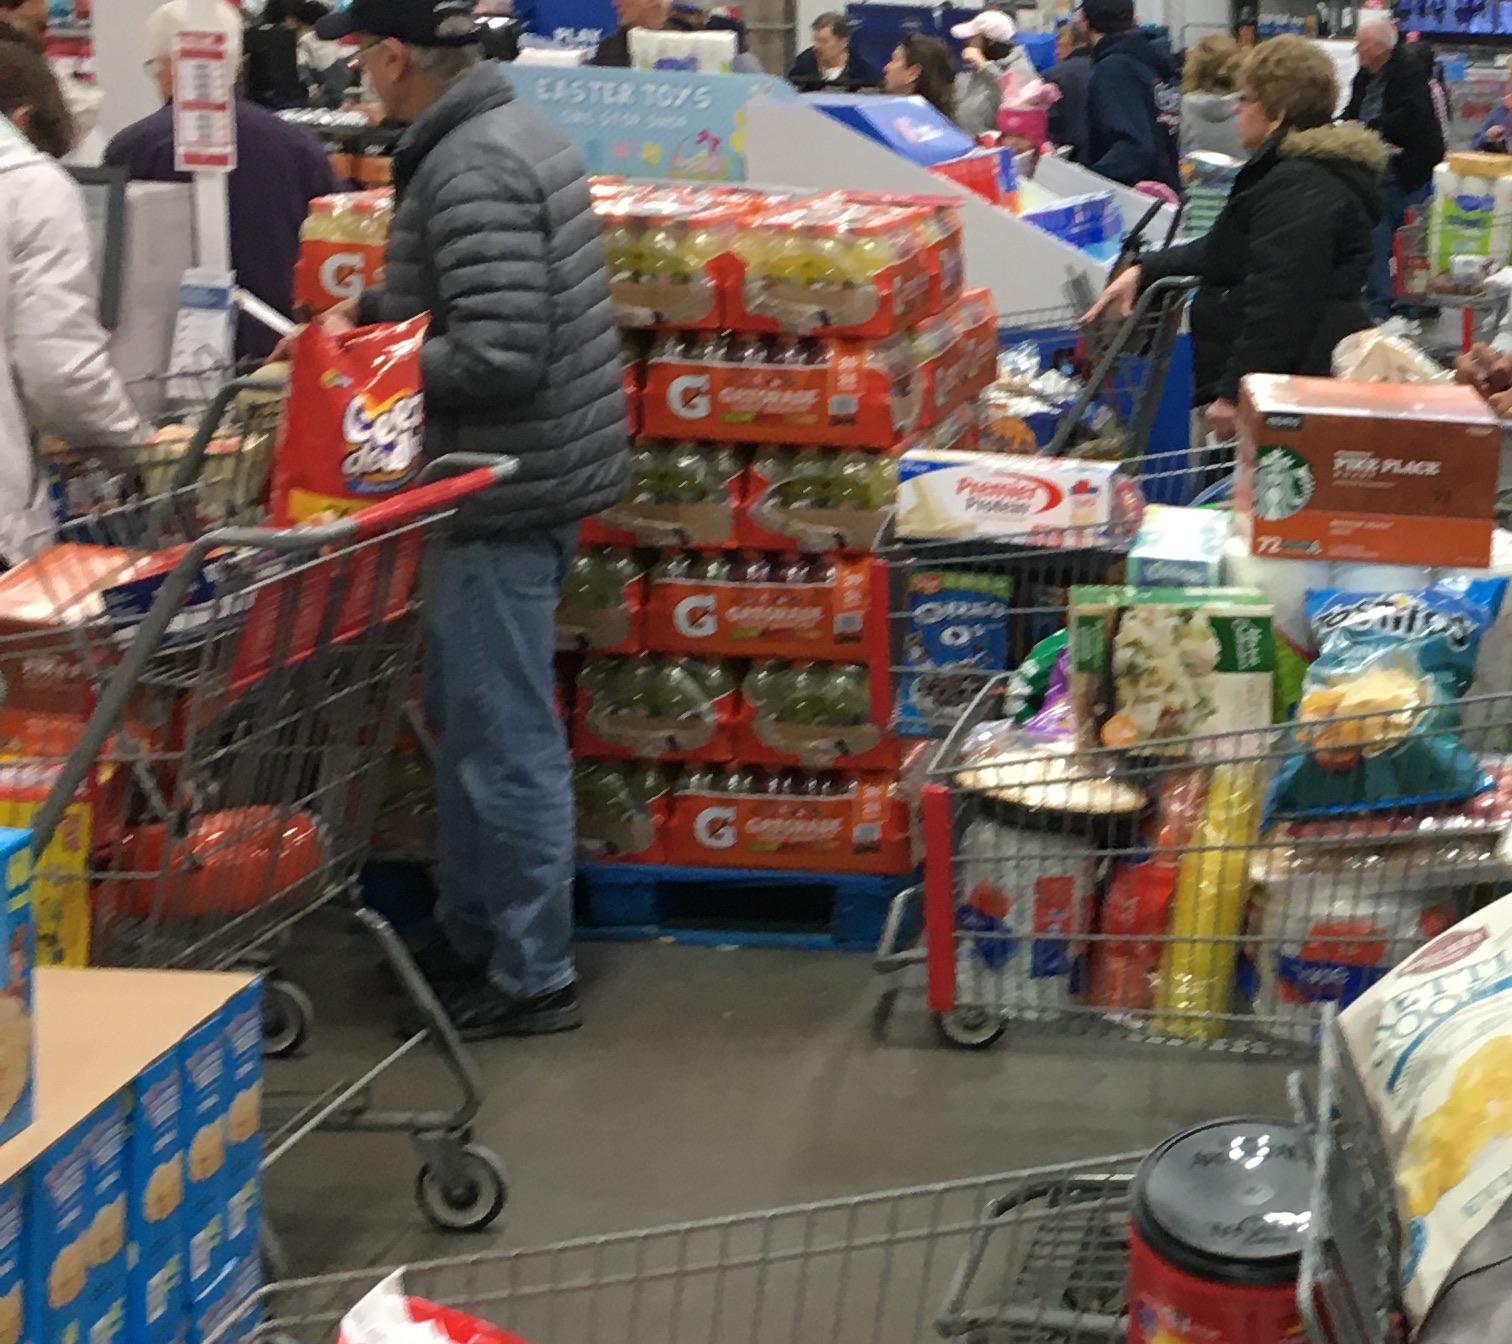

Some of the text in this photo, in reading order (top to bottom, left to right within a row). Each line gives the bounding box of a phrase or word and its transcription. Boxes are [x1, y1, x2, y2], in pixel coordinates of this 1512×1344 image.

[537, 76, 712, 109] EASTER TOYS
[319, 252, 365, 299] G
[666, 374, 711, 420] G
[1333, 456, 1442, 476] PIKE PLACE
[955, 475, 1042, 501] Premier
[965, 496, 1031, 514] Protein
[1256, 535, 1283, 554] 72
[673, 593, 718, 639] G
[693, 806, 738, 850] G
